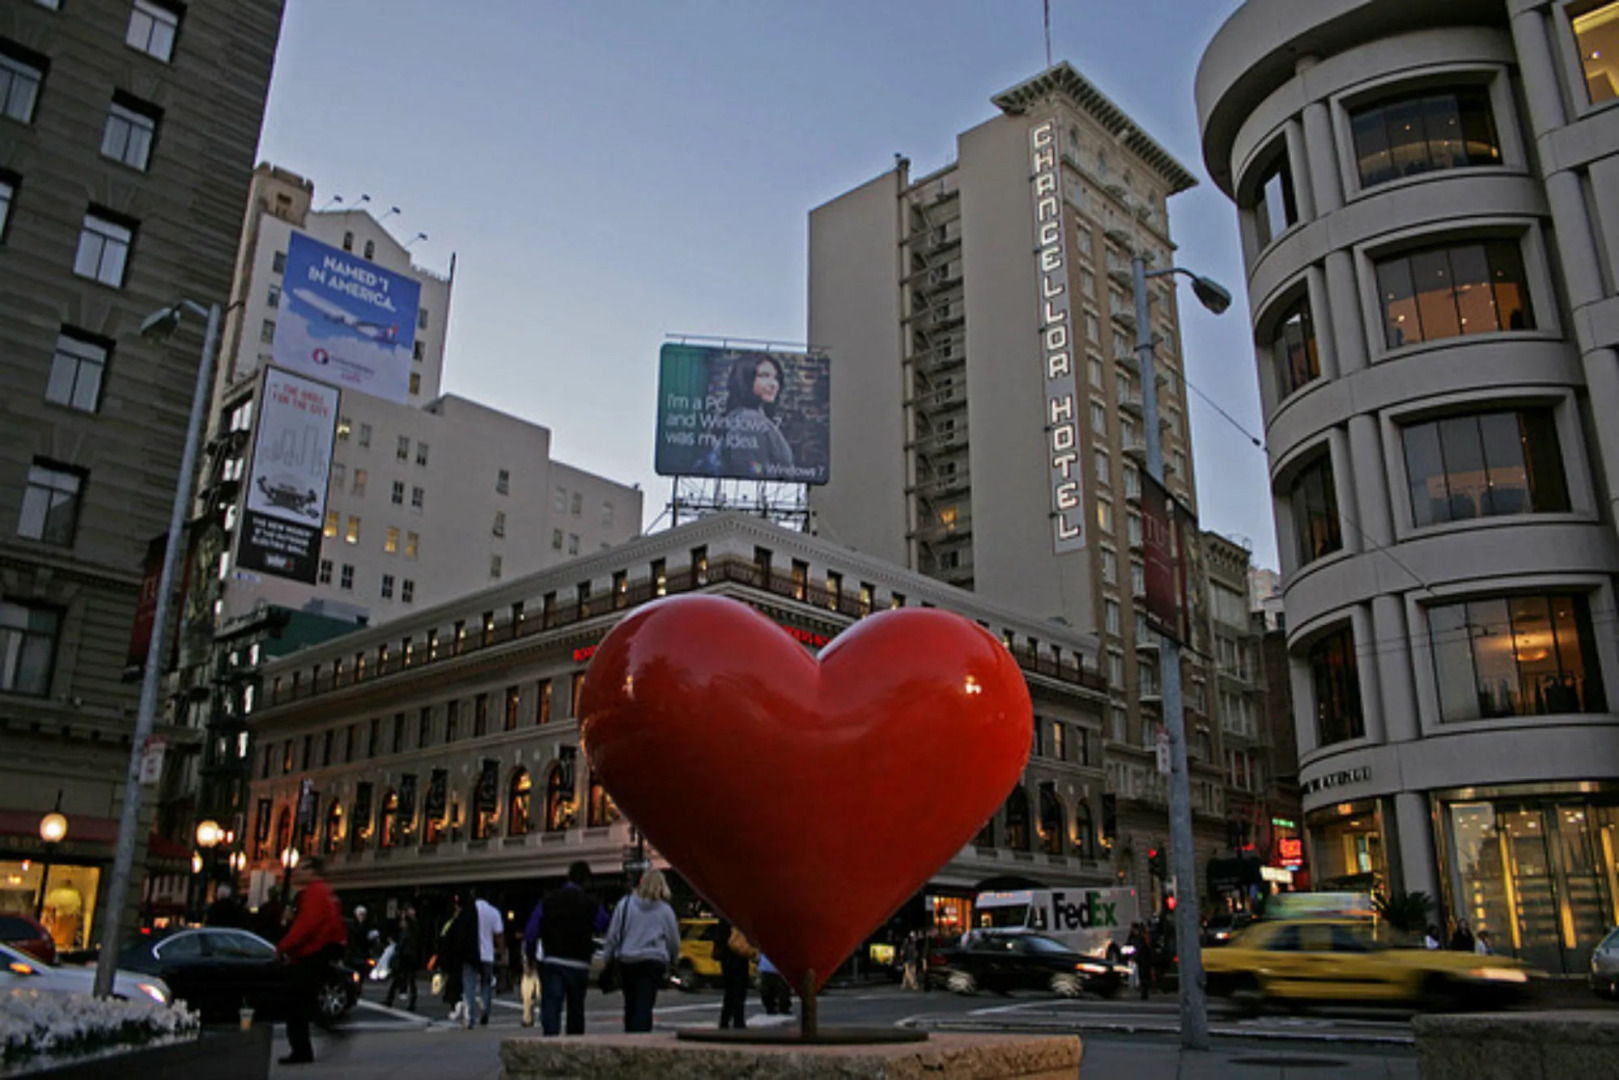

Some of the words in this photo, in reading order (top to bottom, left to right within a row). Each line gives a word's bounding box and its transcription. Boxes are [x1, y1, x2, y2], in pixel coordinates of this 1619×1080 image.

[1033, 122, 1070, 378] CHANCELLOR
[308, 266, 326, 284] IN
[323, 255, 377, 287] NAMED
[667, 393, 689, 410] I'm
[693, 399, 702, 411] a
[705, 396, 728, 414] PC
[665, 411, 697, 428] and
[700, 411, 772, 434] Windows
[665, 430, 696, 447] was
[698, 434, 722, 453] my
[766, 462, 816, 478] Windows
[817, 467, 826, 477] 7
[1051, 396, 1080, 539] HOTEL
[1052, 890, 1118, 931] FedEx
